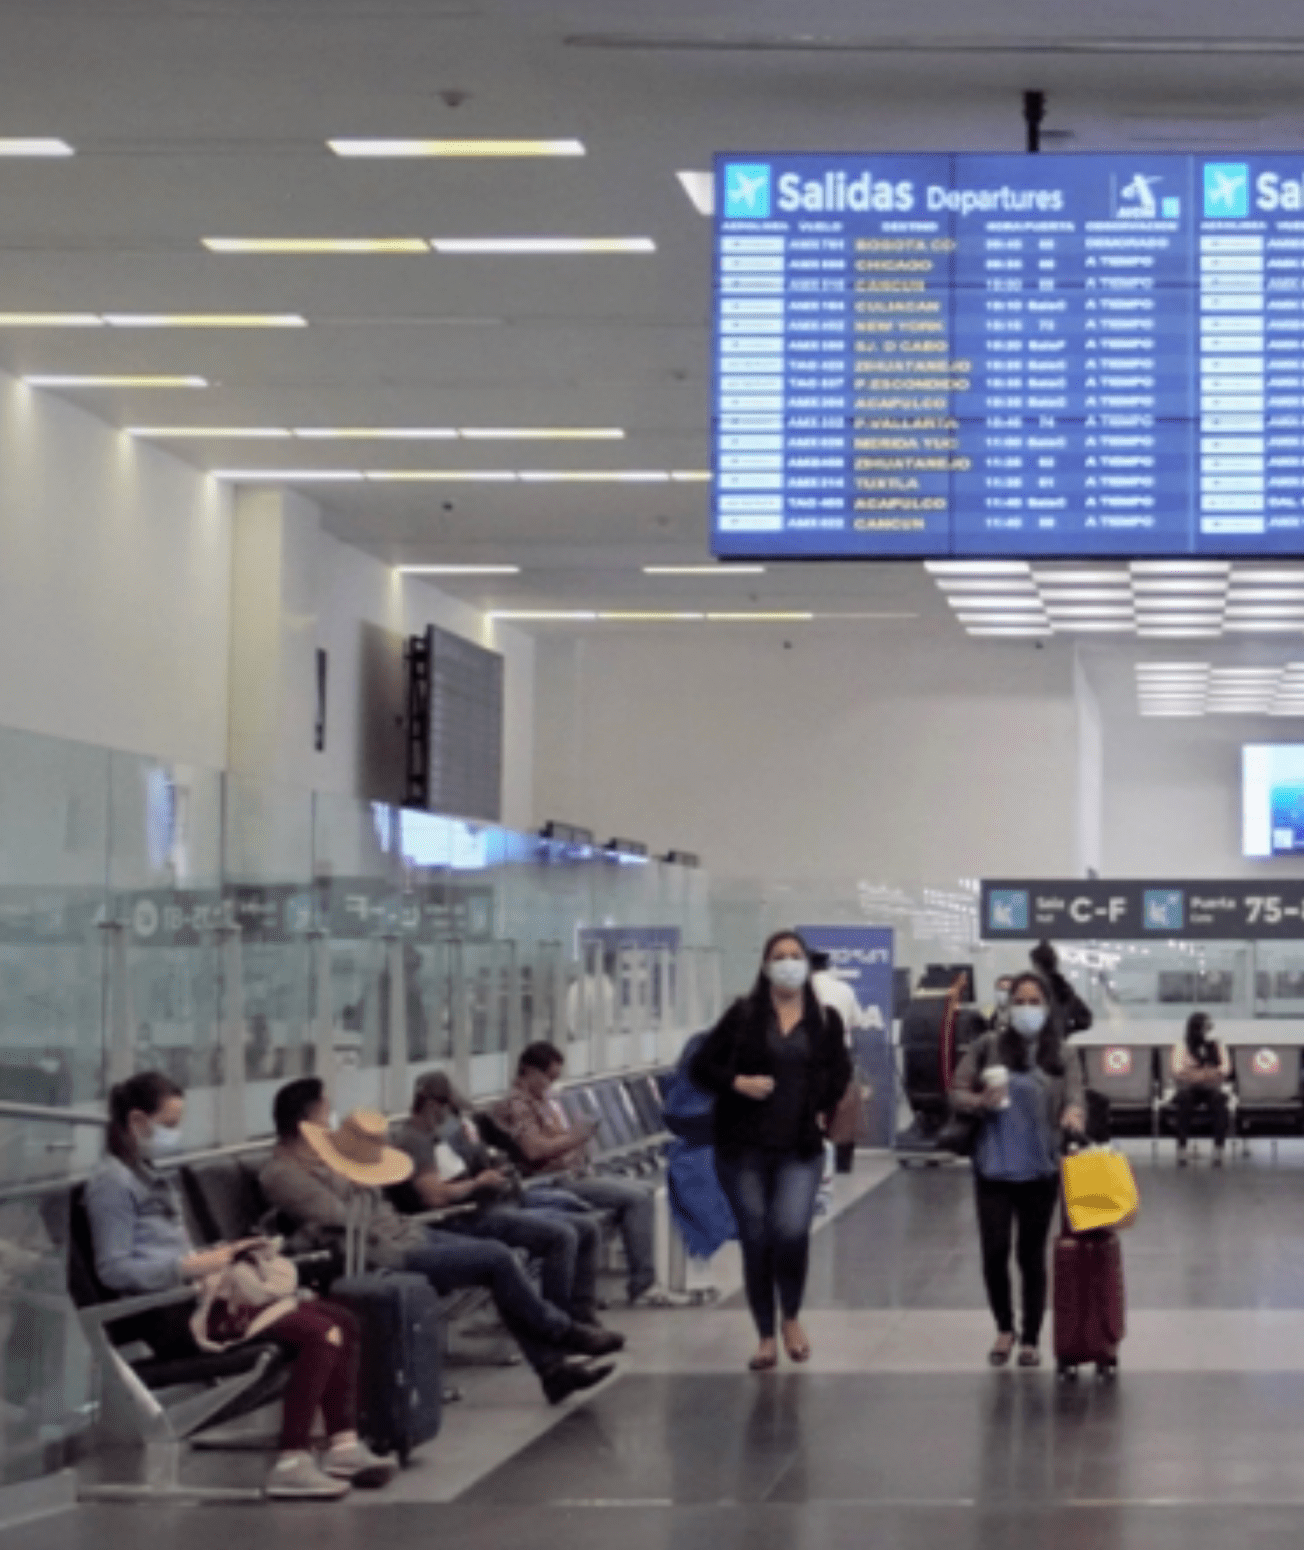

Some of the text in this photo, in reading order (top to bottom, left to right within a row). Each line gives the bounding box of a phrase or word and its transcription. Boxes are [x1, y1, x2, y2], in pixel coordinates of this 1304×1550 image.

[777, 171, 1063, 215] Salidas Departures
[854, 259, 934, 271] CHICAGO
[853, 397, 948, 410] ACAPULCO
[853, 497, 948, 510] ACAPULCO
[853, 518, 926, 530] CANCUN
[1069, 896, 1128, 924] C-F
